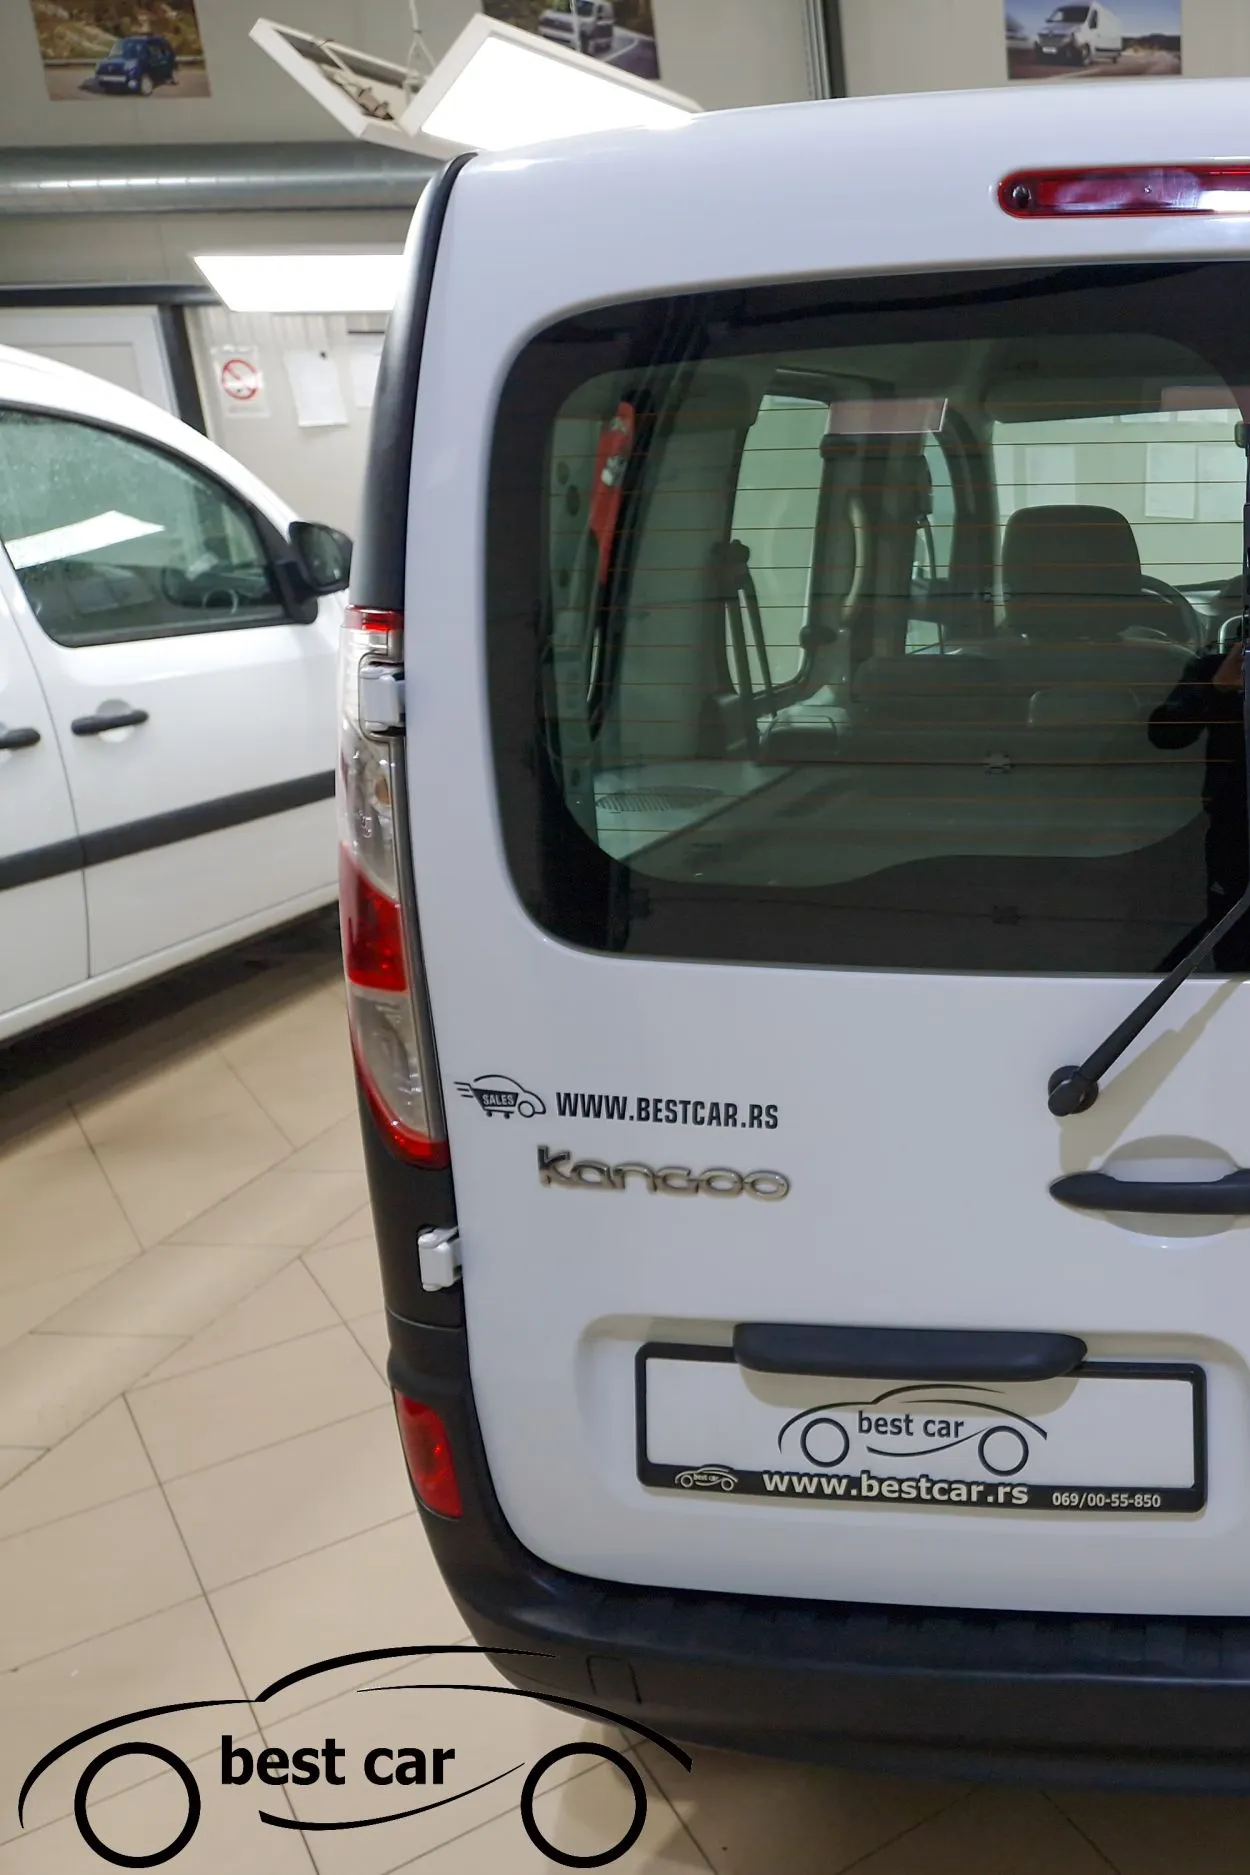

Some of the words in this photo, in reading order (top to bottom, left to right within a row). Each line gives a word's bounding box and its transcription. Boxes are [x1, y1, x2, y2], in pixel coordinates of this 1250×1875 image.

[482, 1094, 514, 1106] SALES
[556, 1092, 779, 1129] WWW.BESTCAR.RS
[857, 1410, 915, 1437] best
[922, 1418, 965, 1439] car
[762, 1471, 1029, 1505] www.bestcar.rs
[1051, 1492, 1162, 1508] 069/00-55-850
